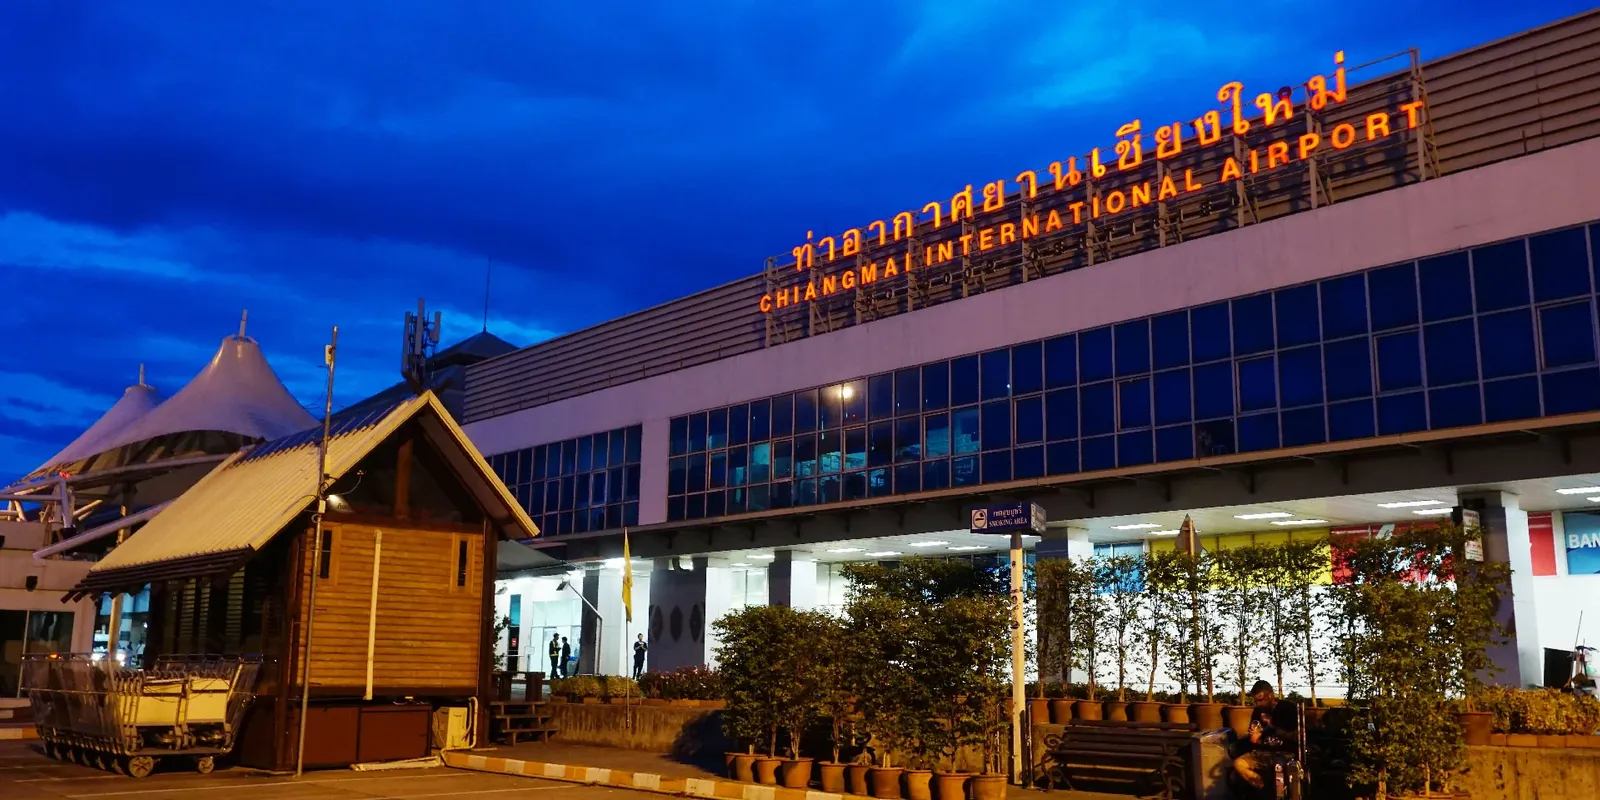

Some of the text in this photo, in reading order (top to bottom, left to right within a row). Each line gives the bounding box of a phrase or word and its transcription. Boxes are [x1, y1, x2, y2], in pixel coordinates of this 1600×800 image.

[759, 100, 1425, 313] CHIANGMAI INTERNATIONAL AIRPORT
[792, 51, 1348, 272] ท่าอากาศยานเชียงใหม่
[989, 517, 1028, 527] SMOKING AREA
